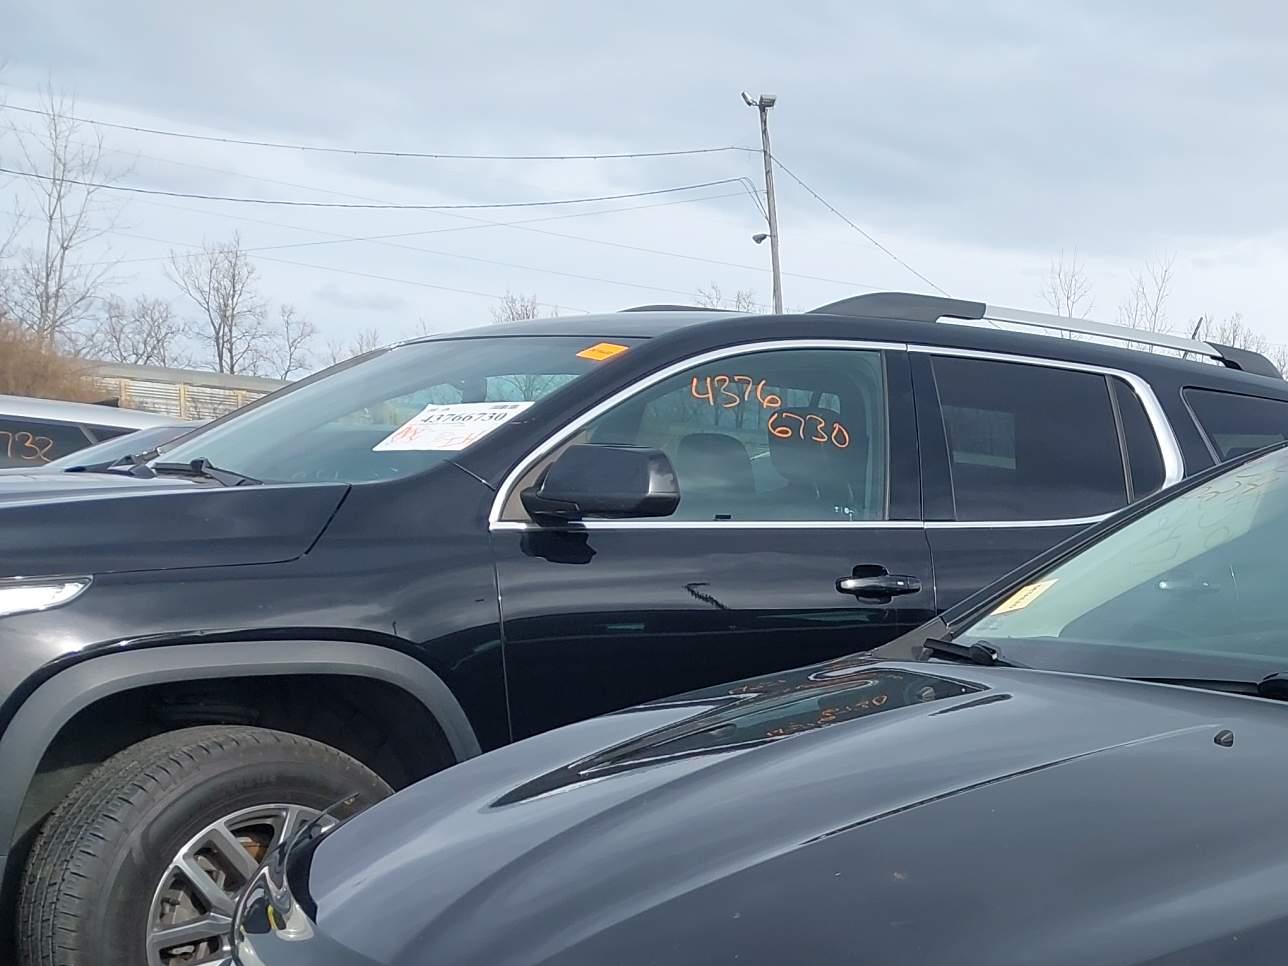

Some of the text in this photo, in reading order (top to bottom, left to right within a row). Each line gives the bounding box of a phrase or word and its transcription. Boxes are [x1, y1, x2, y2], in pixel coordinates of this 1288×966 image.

[691, 375, 782, 408] 4376
[421, 412, 508, 424] 43766730
[768, 413, 849, 448] 6730
